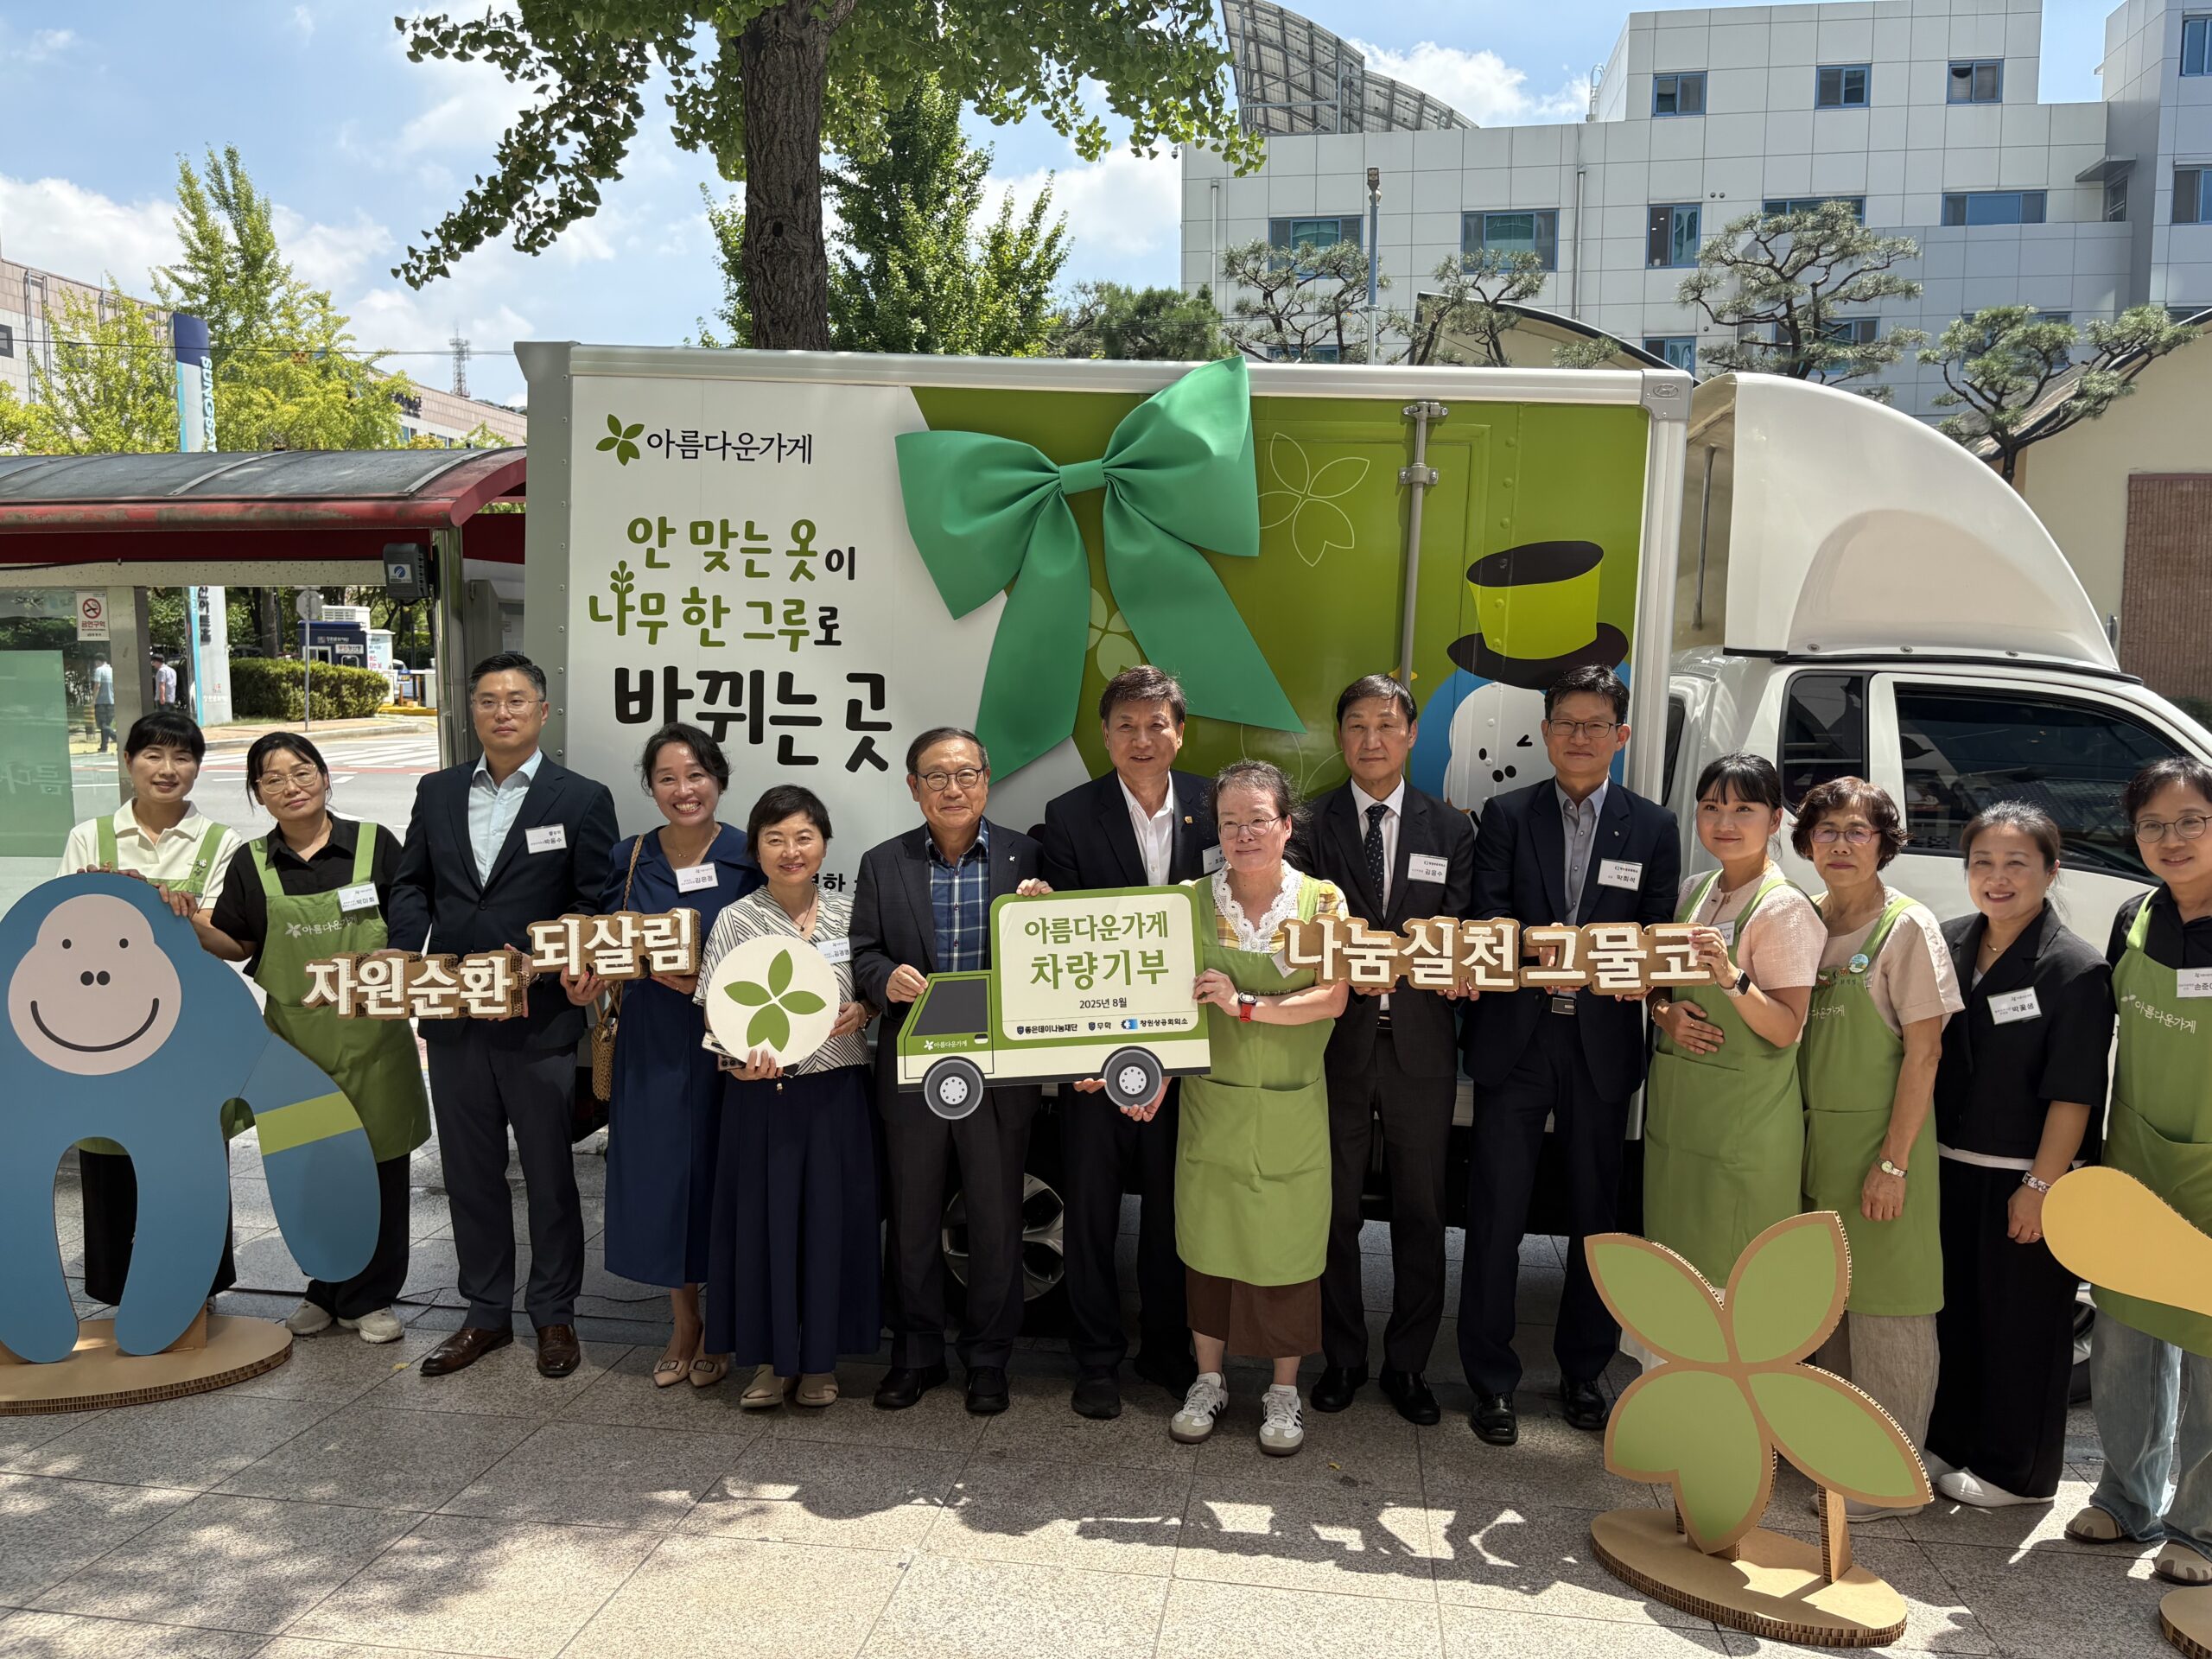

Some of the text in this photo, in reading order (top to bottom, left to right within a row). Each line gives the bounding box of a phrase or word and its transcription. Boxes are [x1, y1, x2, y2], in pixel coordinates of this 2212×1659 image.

[646, 428, 812, 465] 아름다운가게
[627, 516, 855, 582] 안 맞는 옷이
[588, 566, 842, 652] 나무 한 그루로
[614, 665, 893, 773] 바뀌는 곳
[302, 915, 359, 936] 아름다운가게
[531, 908, 691, 976] 되살림
[1024, 910, 1168, 945] 아름다운가게
[1030, 950, 1169, 991] 차량기부
[1284, 918, 1711, 988] 나눔실천 그물코
[302, 957, 513, 1016] 자원순환
[1079, 996, 1128, 1009] 2025년 8월
[1025, 1017, 1188, 1034] 좋은데이나눔재단 무학 창원상공회의소
[1811, 1005, 1845, 1020] 다운가게
[2134, 1001, 2196, 1034] 아름다운가게
